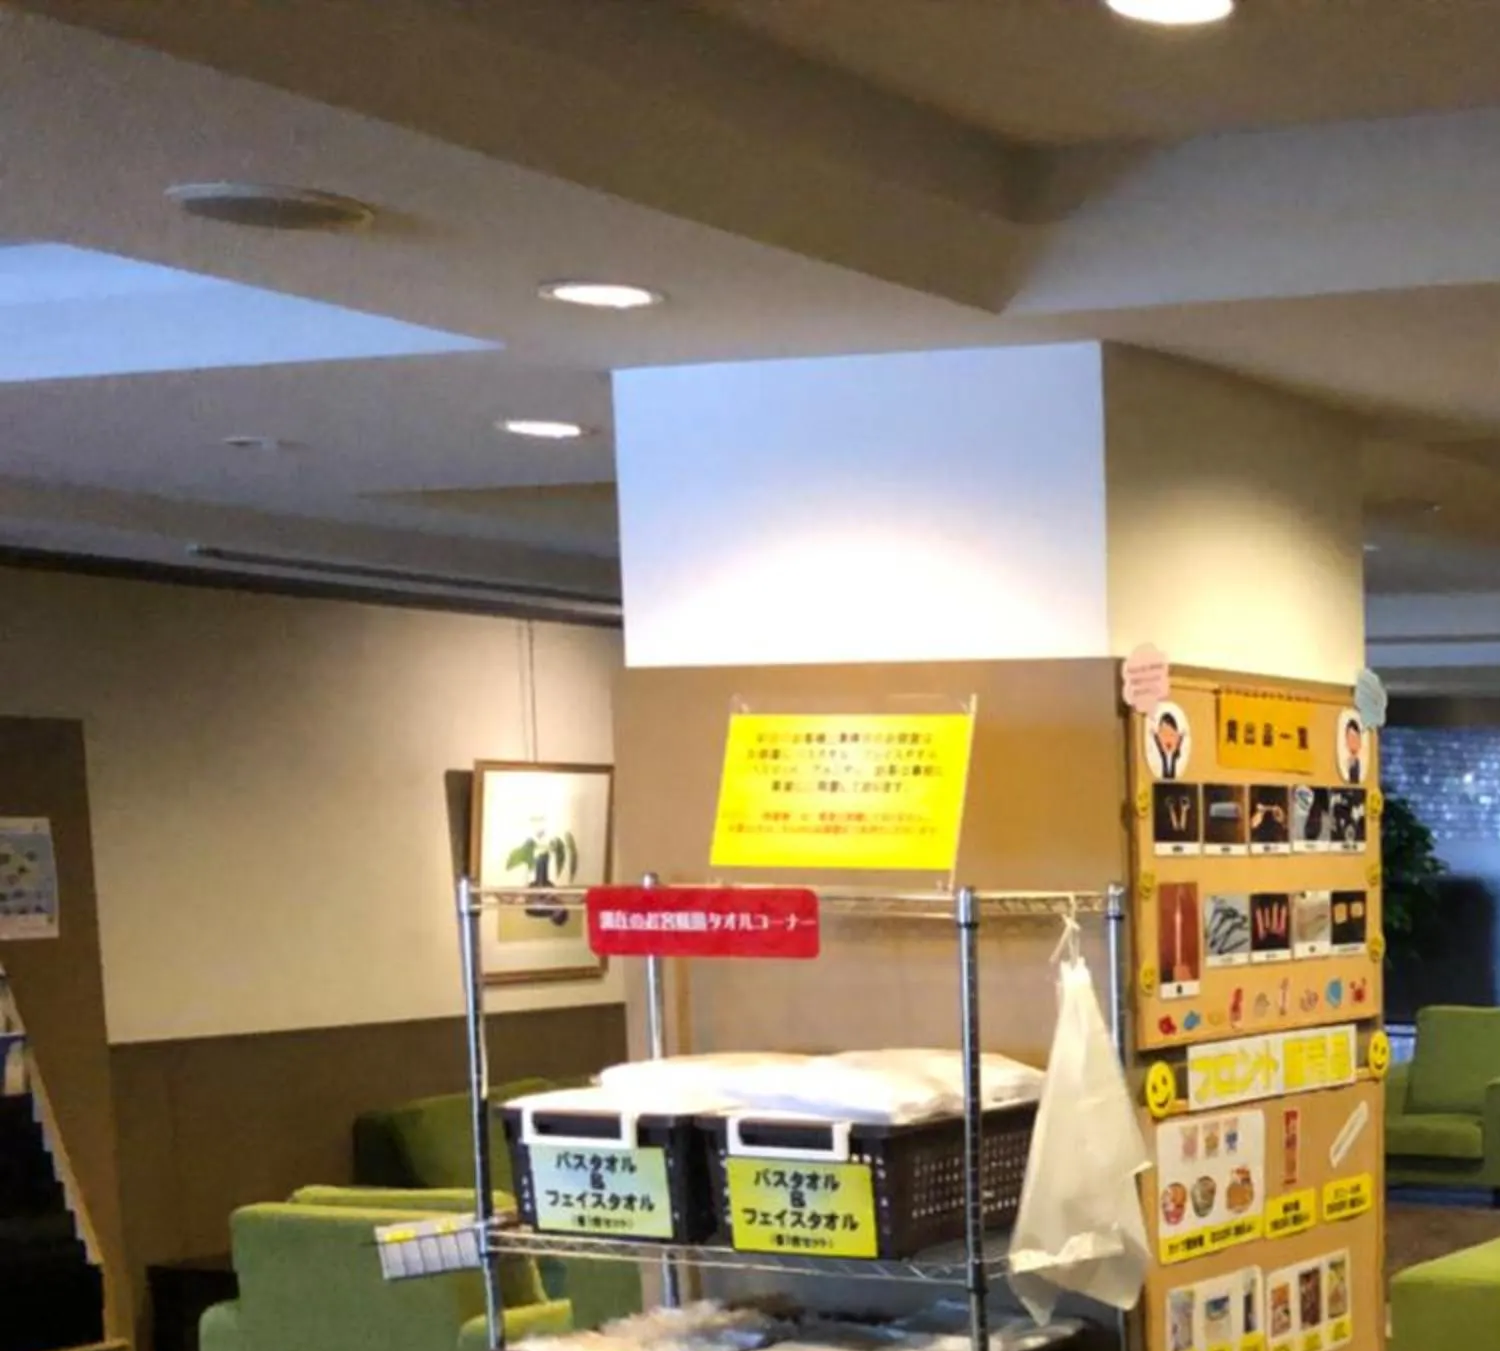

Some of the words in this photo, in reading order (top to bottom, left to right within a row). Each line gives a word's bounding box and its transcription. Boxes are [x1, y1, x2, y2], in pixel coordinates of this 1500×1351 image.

[555, 1152, 637, 1174] バスタオル
[754, 1168, 840, 1190] バスタオル
[545, 1189, 655, 1212] フェイスタオル
[742, 1207, 859, 1231] フェイスタオル
